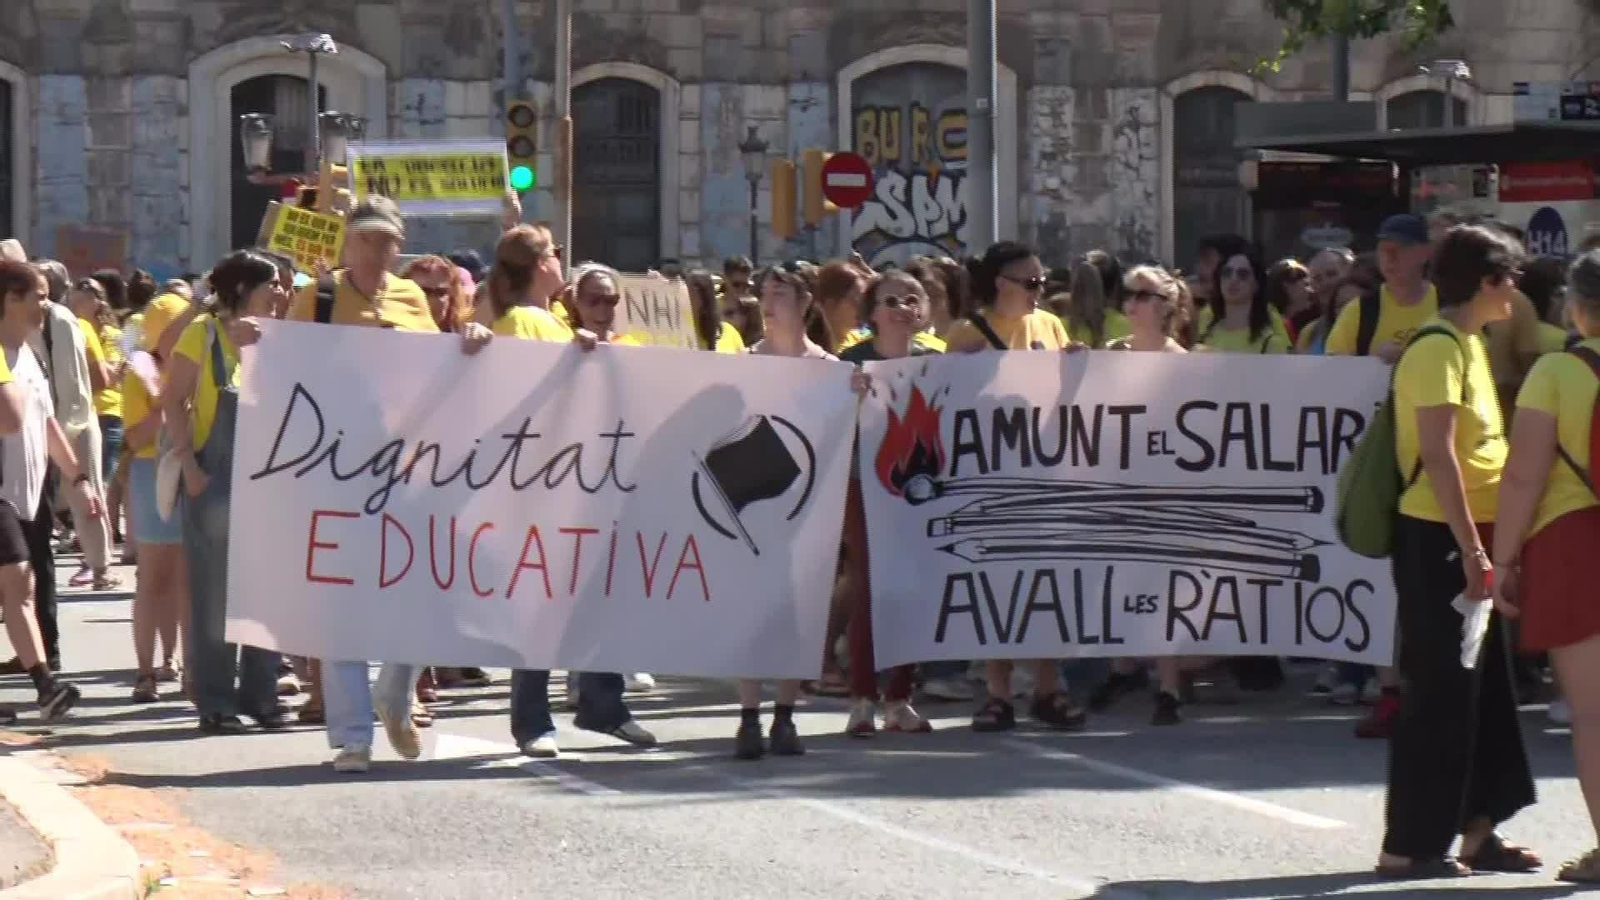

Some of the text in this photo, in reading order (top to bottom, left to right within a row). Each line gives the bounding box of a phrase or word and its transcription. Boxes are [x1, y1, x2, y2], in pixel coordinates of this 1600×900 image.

[249, 382, 637, 516] Dignitat
[949, 400, 1381, 477] AMUNT EL SALAR
[934, 565, 1125, 646] AVALL
[1123, 593, 1159, 615] LES
